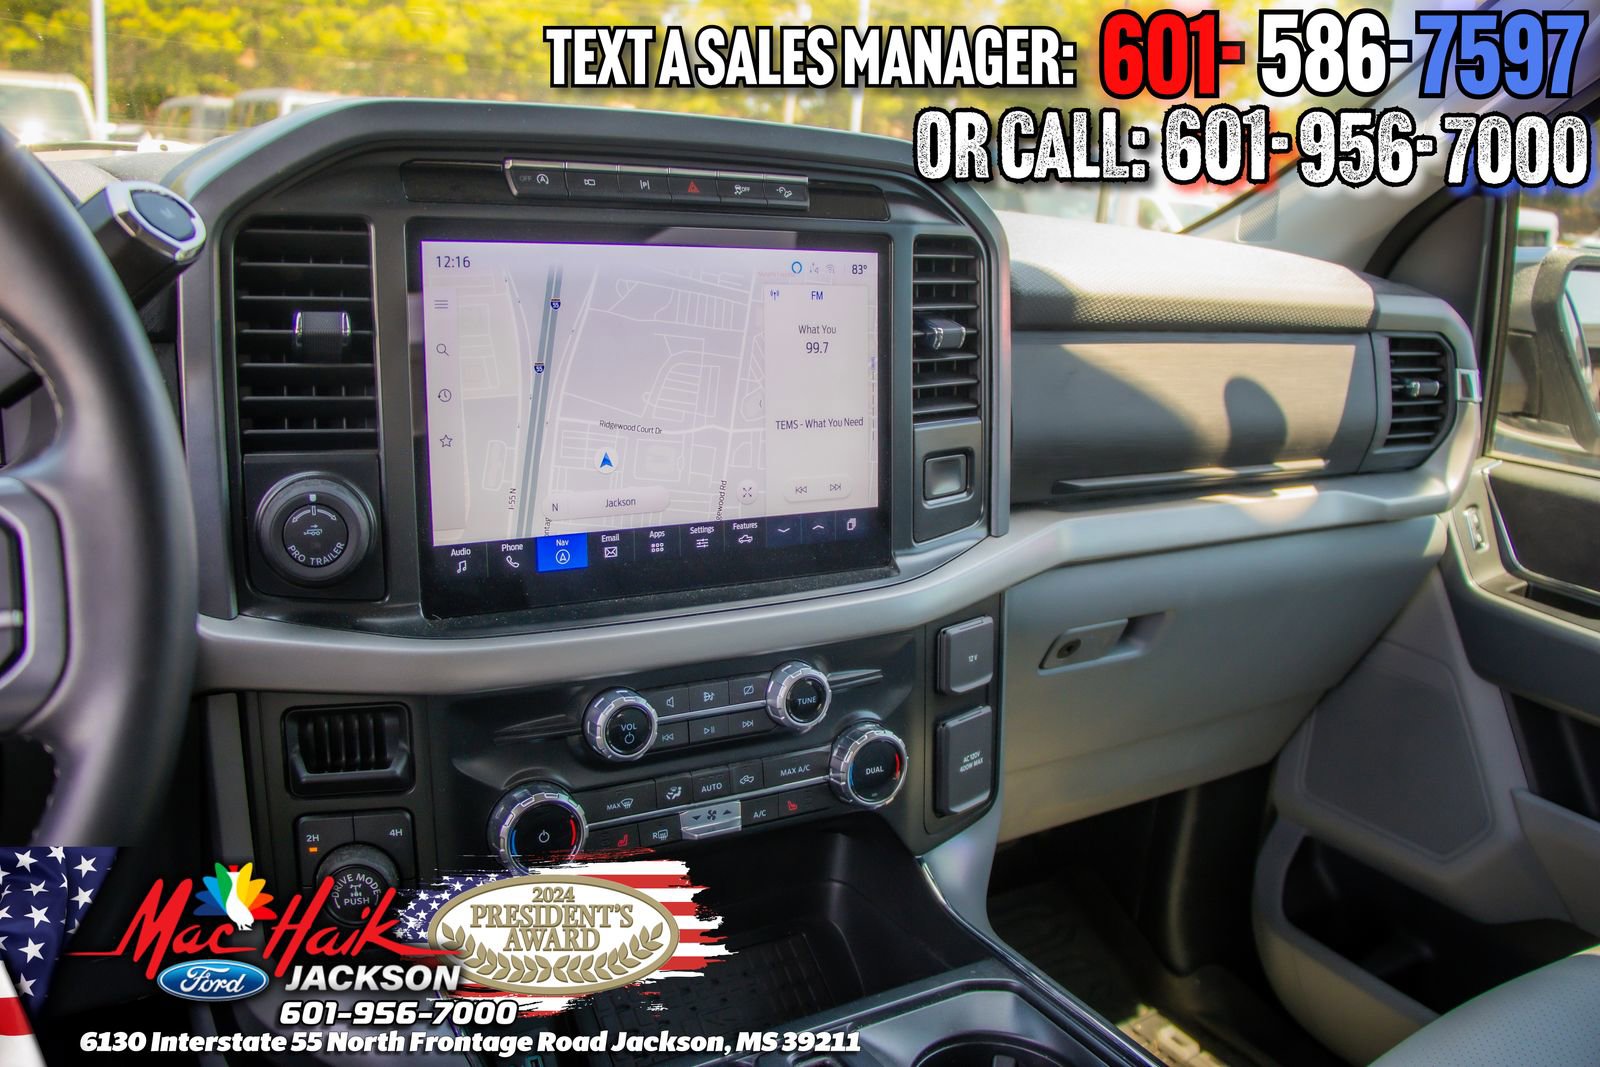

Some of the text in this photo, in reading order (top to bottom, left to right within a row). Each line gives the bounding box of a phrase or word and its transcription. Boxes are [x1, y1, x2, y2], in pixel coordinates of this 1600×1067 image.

[435, 255, 471, 268] 12:16
[811, 290, 824, 300] FM
[798, 324, 837, 334] What You
[805, 341, 829, 354] 99.7
[599, 419, 663, 435] Ridgewood Court Dr
[776, 420, 799, 430] TEMS
[805, 419, 826, 429] What
[828, 418, 843, 428] You
[844, 417, 864, 427] Need
[720, 480, 728, 490] Rd
[551, 503, 559, 511] N
[605, 497, 637, 508] Jackson
[689, 525, 715, 535] Settings
[732, 521, 758, 530] Features
[601, 533, 620, 543] Email
[649, 530, 666, 539] Apps
[501, 542, 524, 552] Phone
[555, 539, 570, 547] Nav
[287, 541, 345, 566] PRO TRAILER
[450, 547, 471, 557] Audio
[797, 696, 817, 705] TUNE
[620, 723, 637, 731] VOL
[780, 764, 811, 777] MAX A/C
[865, 766, 885, 776] DUAL
[701, 783, 723, 793] AUTO
[606, 803, 621, 811] MAX
[753, 809, 767, 819] A/C
[306, 834, 320, 842] 2H
[389, 829, 403, 837] 4H
[331, 873, 382, 898] DRIVE MODE
[343, 897, 370, 906] PUSH
